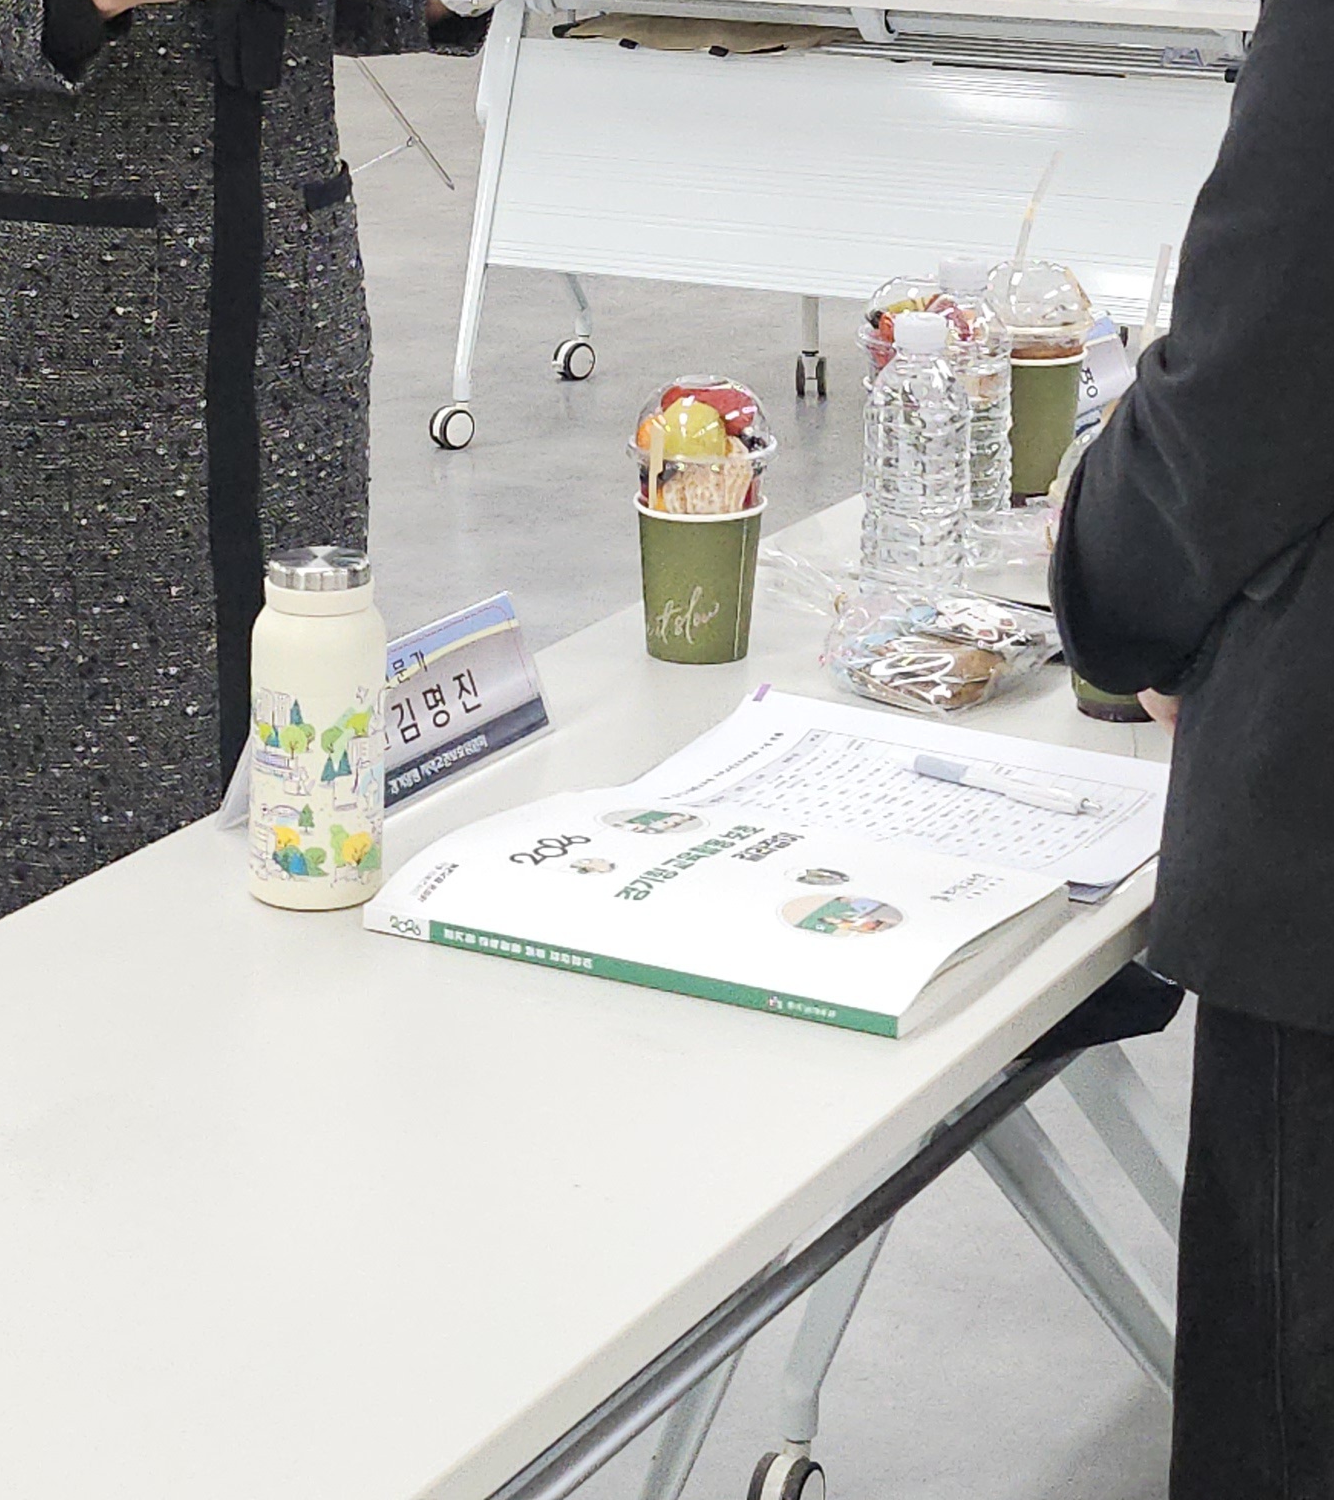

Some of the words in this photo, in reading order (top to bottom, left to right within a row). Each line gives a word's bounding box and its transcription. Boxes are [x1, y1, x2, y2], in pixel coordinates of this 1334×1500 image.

[385, 649, 428, 690] 문가
[391, 668, 483, 745] 김명진
[509, 835, 591, 865] 2026
